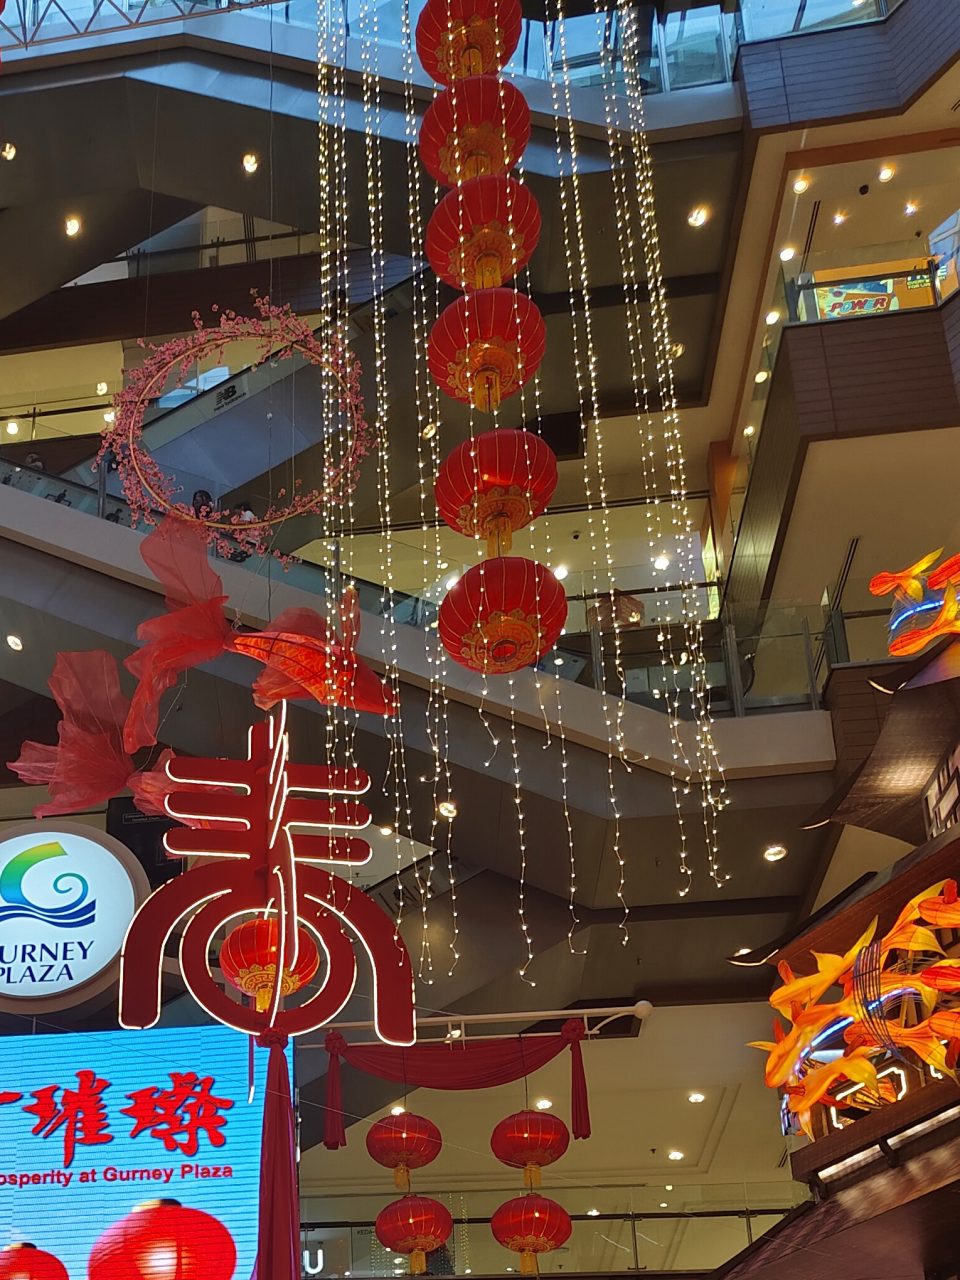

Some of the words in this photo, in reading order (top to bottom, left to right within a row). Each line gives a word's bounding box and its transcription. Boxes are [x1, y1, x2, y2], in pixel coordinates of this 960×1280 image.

[79, 1169, 97, 1184] at
[103, 1166, 172, 1184] Gurney
[181, 1163, 233, 1180] Plaza
